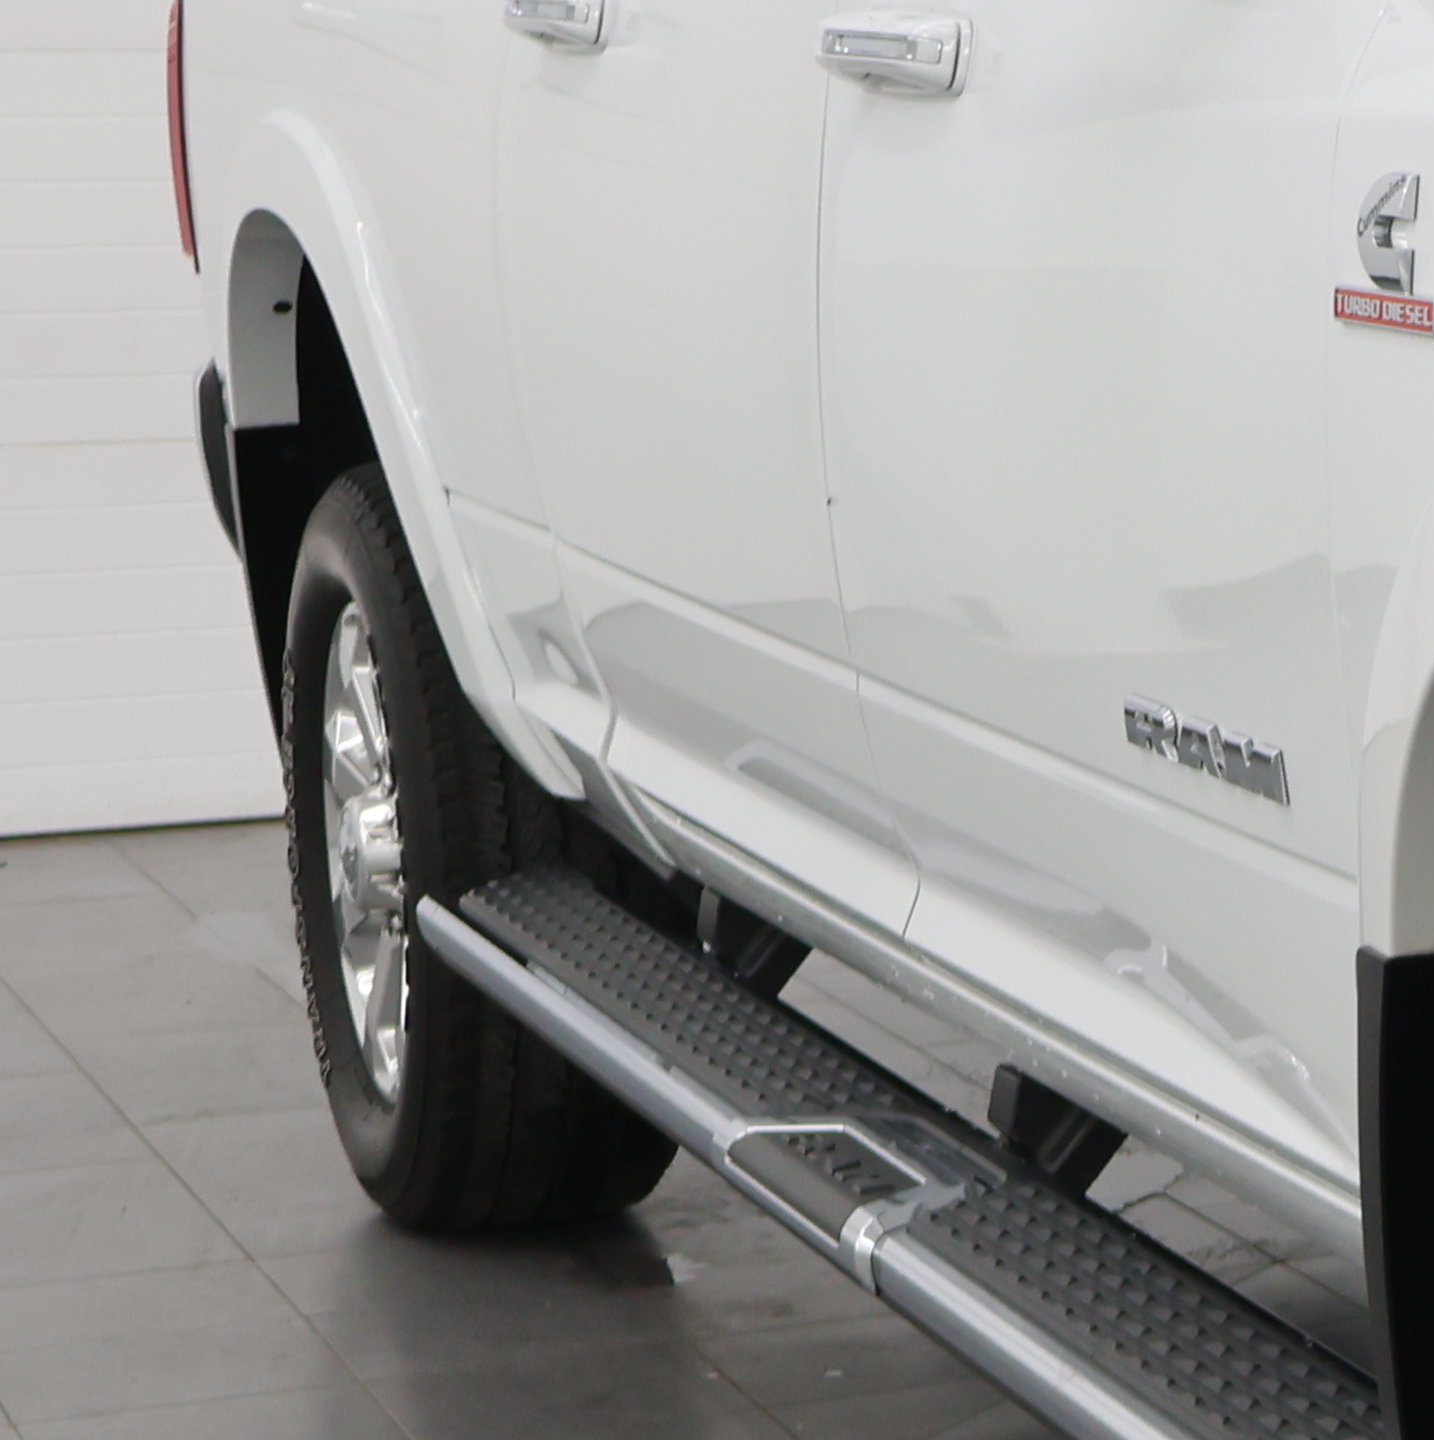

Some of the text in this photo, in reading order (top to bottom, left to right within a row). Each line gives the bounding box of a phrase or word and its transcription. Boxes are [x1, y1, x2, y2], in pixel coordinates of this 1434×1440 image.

[1356, 173, 1407, 236] Cummins
[1336, 292, 1434, 327] TURBO DIESEL
[1123, 694, 1290, 807] RAM
